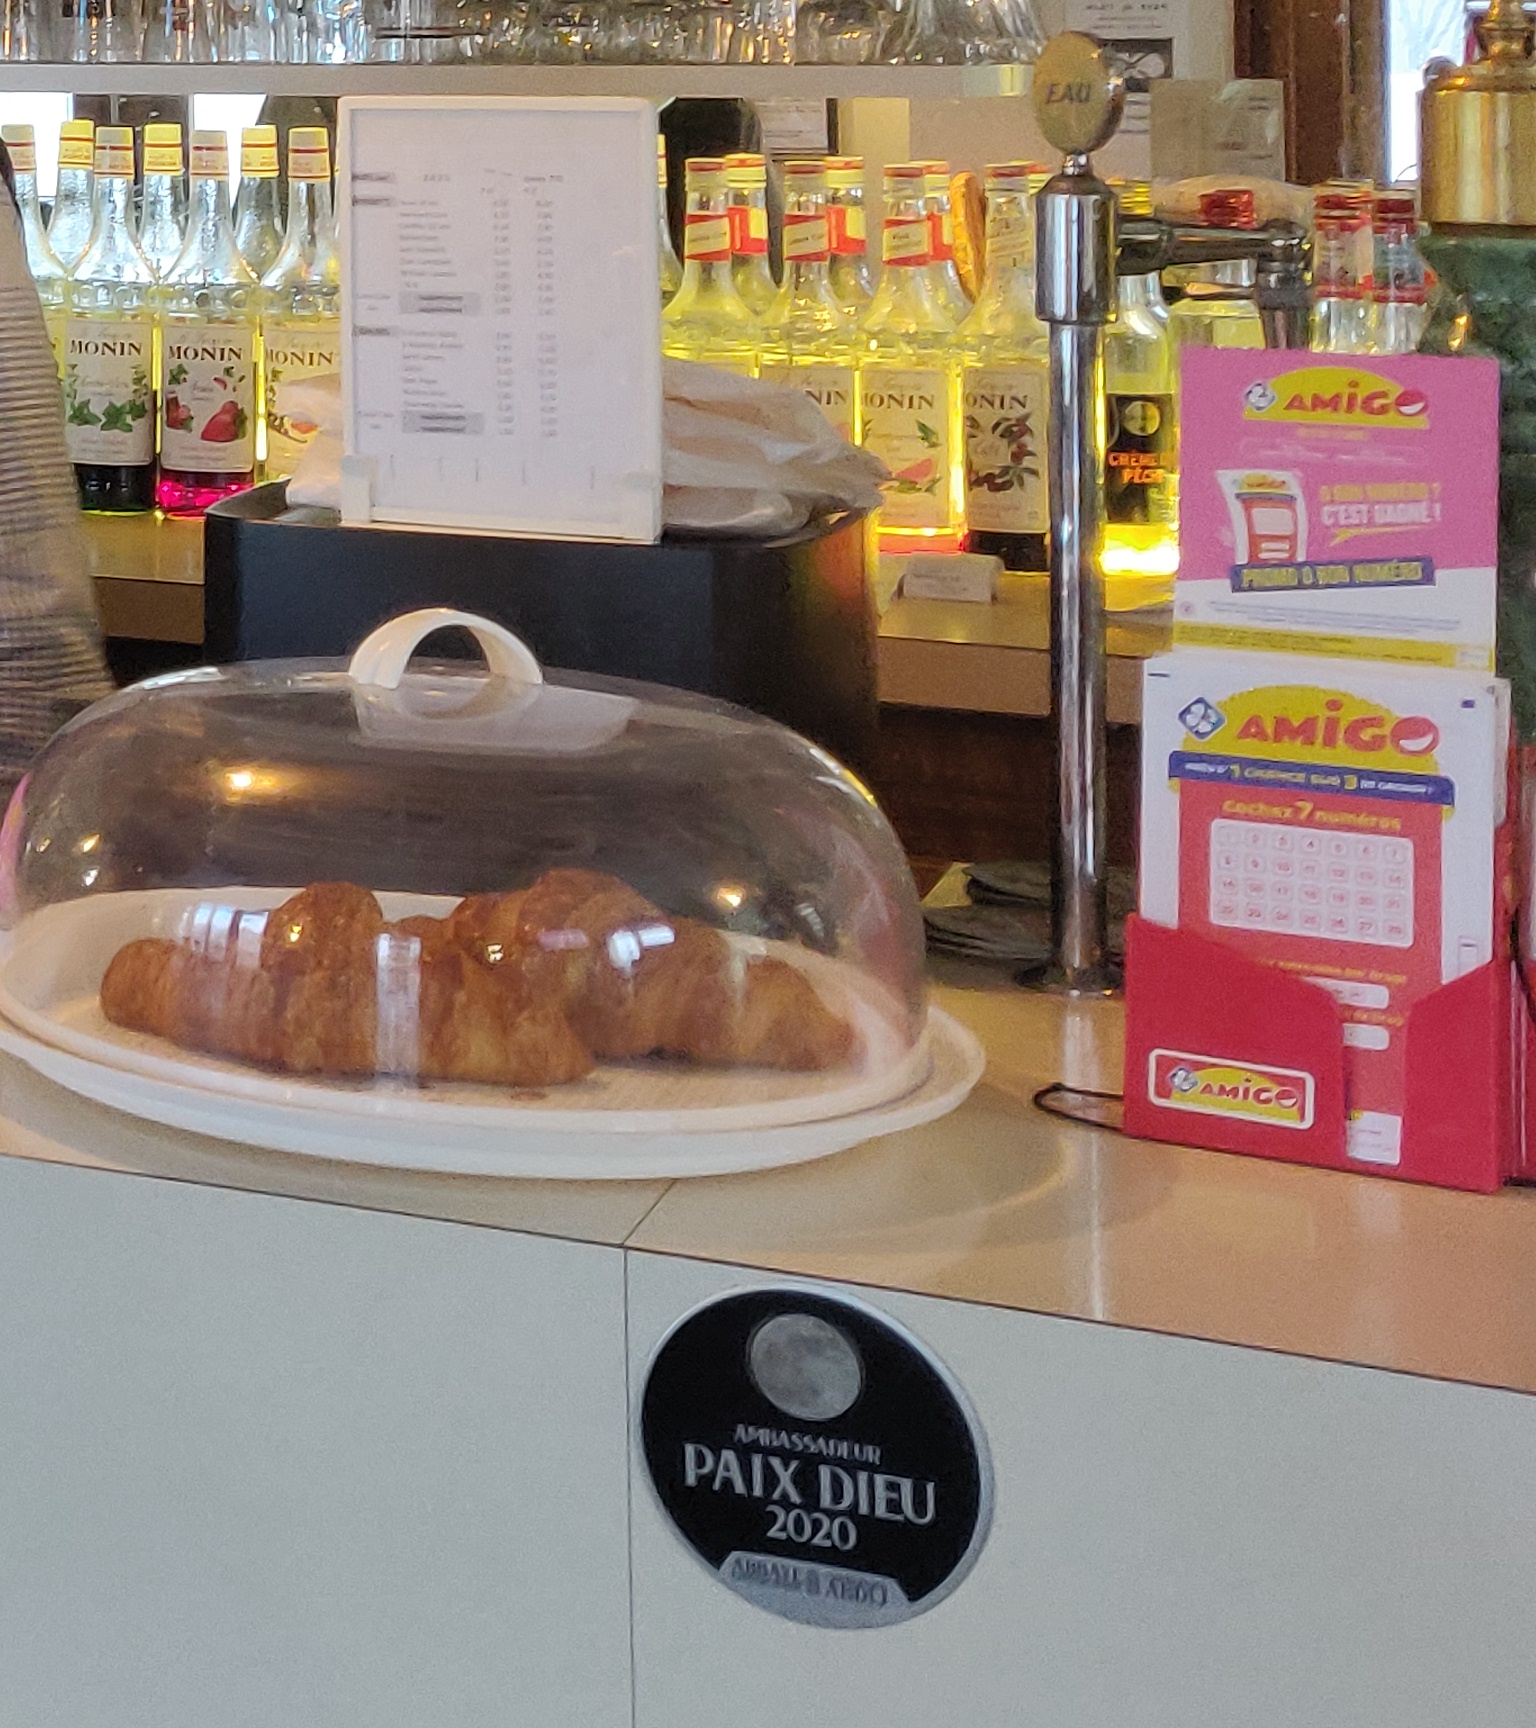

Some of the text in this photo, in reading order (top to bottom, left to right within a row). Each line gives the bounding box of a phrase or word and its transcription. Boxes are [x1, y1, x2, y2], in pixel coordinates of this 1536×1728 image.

[1046, 83, 1092, 105] EAU
[70, 339, 142, 357] MONIN
[168, 344, 243, 362] MONIN
[964, 393, 1028, 410] ONIN
[734, 1423, 882, 1465] AMBASSADEUR
[684, 1443, 936, 1525] PAIX DIEU
[765, 1504, 858, 1552] 2020
